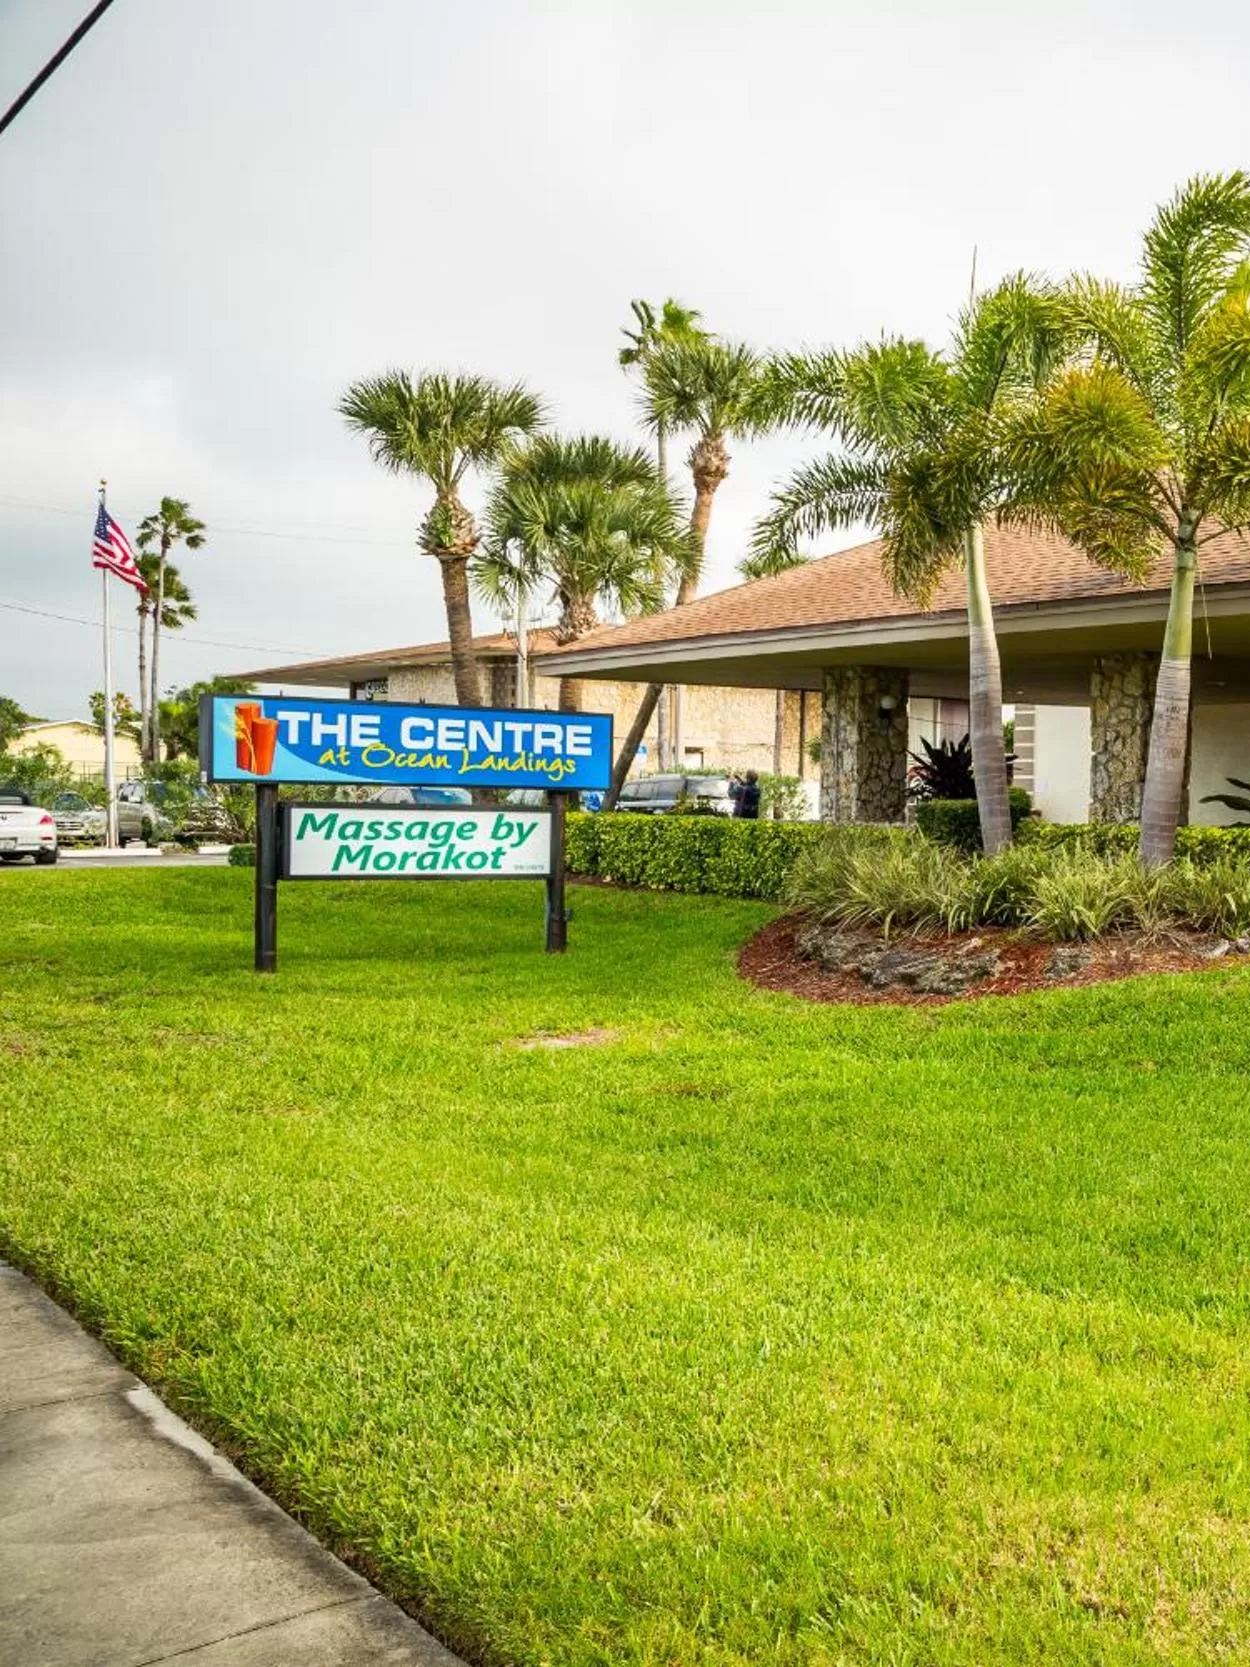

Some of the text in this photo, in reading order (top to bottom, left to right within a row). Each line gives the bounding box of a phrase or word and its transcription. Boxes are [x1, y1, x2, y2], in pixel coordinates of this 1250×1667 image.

[277, 711, 593, 756] THE CENTRE
[319, 742, 577, 782] at Ocean Landings
[296, 812, 539, 848] Massage by
[331, 843, 507, 872] Morakot
